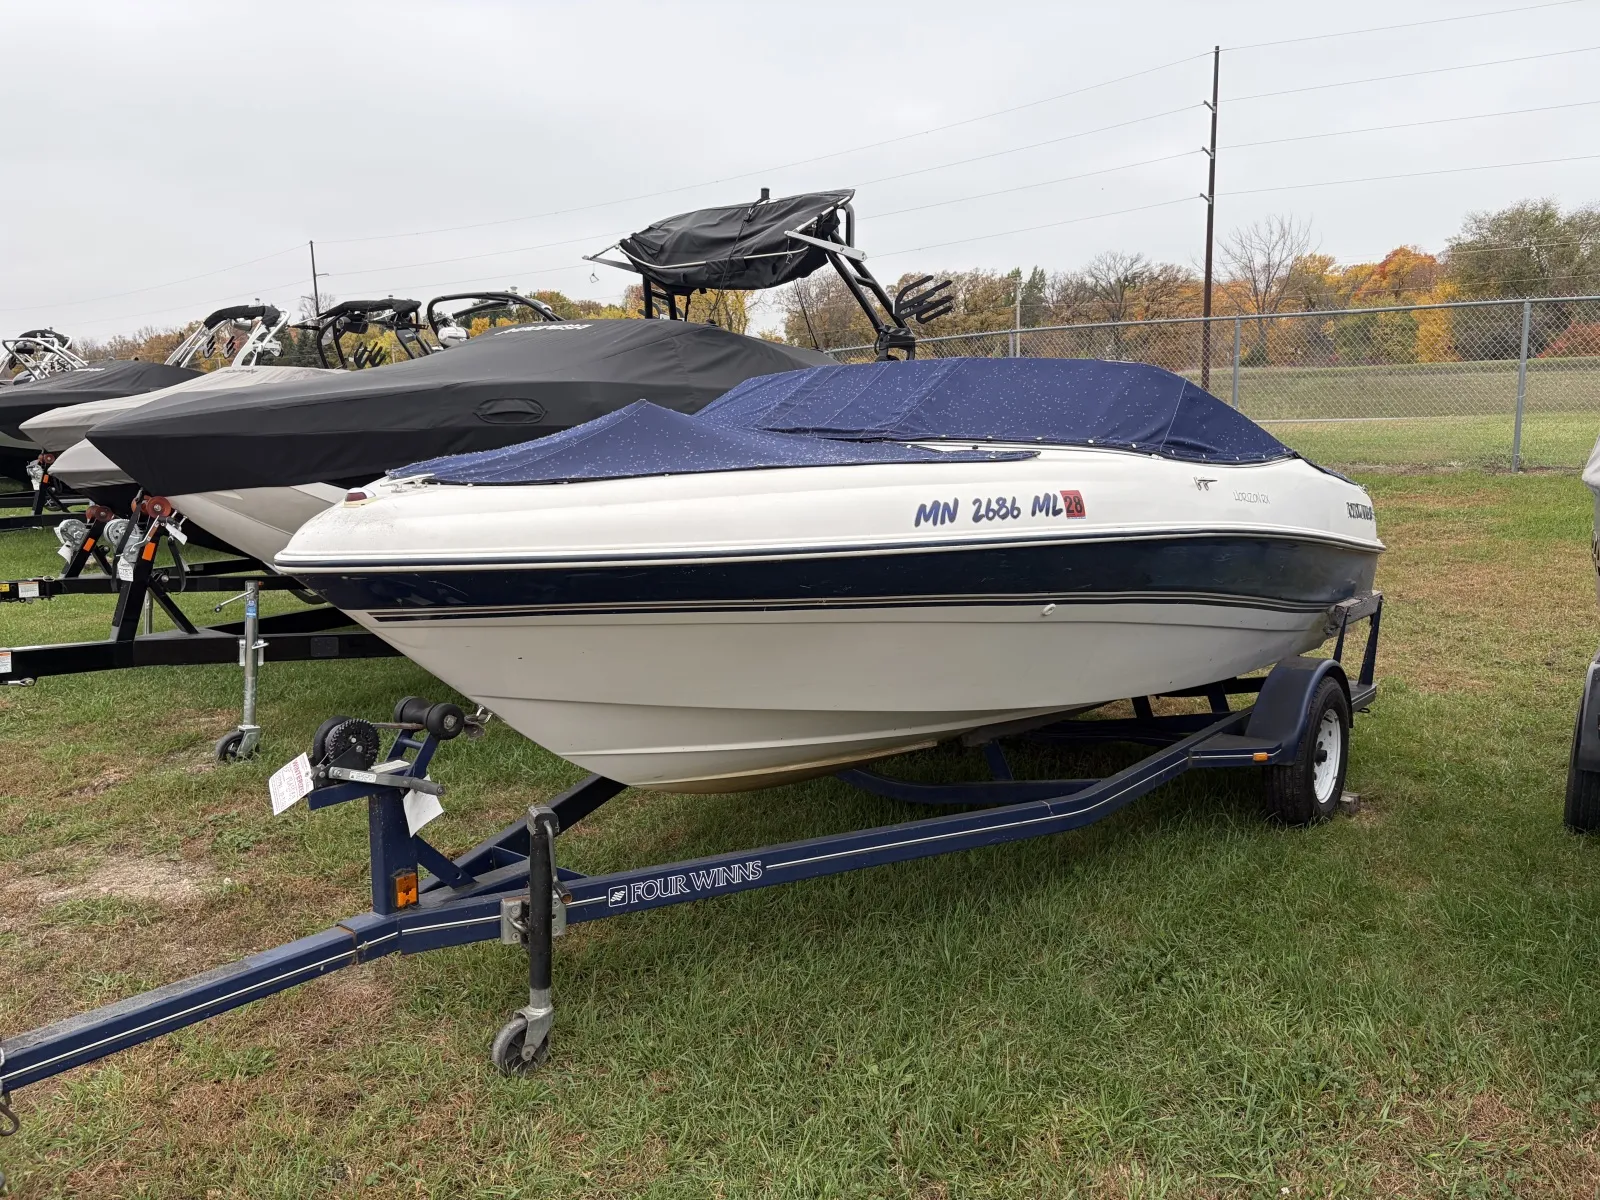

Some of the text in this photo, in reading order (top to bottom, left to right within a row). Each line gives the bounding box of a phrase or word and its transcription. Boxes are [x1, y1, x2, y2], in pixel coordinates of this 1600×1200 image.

[914, 492, 1063, 528] MN 2686 ML
[1064, 495, 1084, 514] 28
[630, 860, 763, 904] FOUR WINNS
